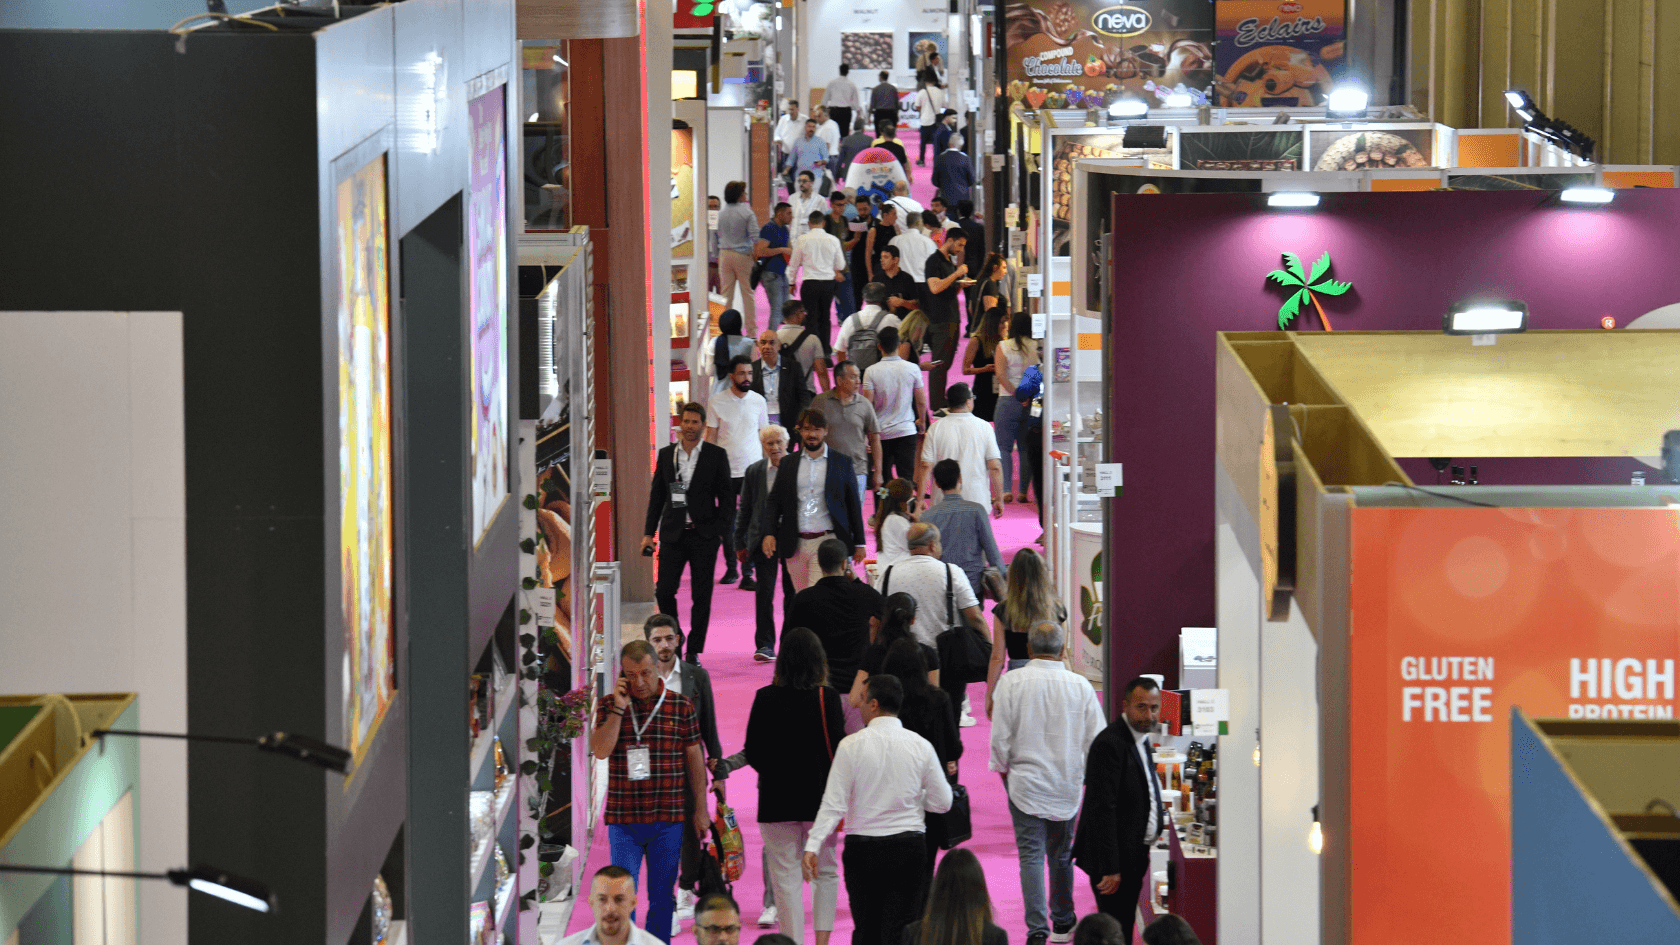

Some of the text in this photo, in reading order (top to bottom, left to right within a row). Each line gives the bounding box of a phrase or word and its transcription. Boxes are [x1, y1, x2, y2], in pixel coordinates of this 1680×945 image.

[1098, 13, 1146, 29] neva
[1234, 15, 1326, 48] Eclairs
[1039, 46, 1074, 61] COMPOUND
[1022, 56, 1083, 77] Chocolate
[1400, 656, 1495, 680] GLUTEN
[1569, 657, 1675, 700] HIGH
[1402, 686, 1494, 723] FREE
[1568, 704, 1674, 720] PROTEIN
